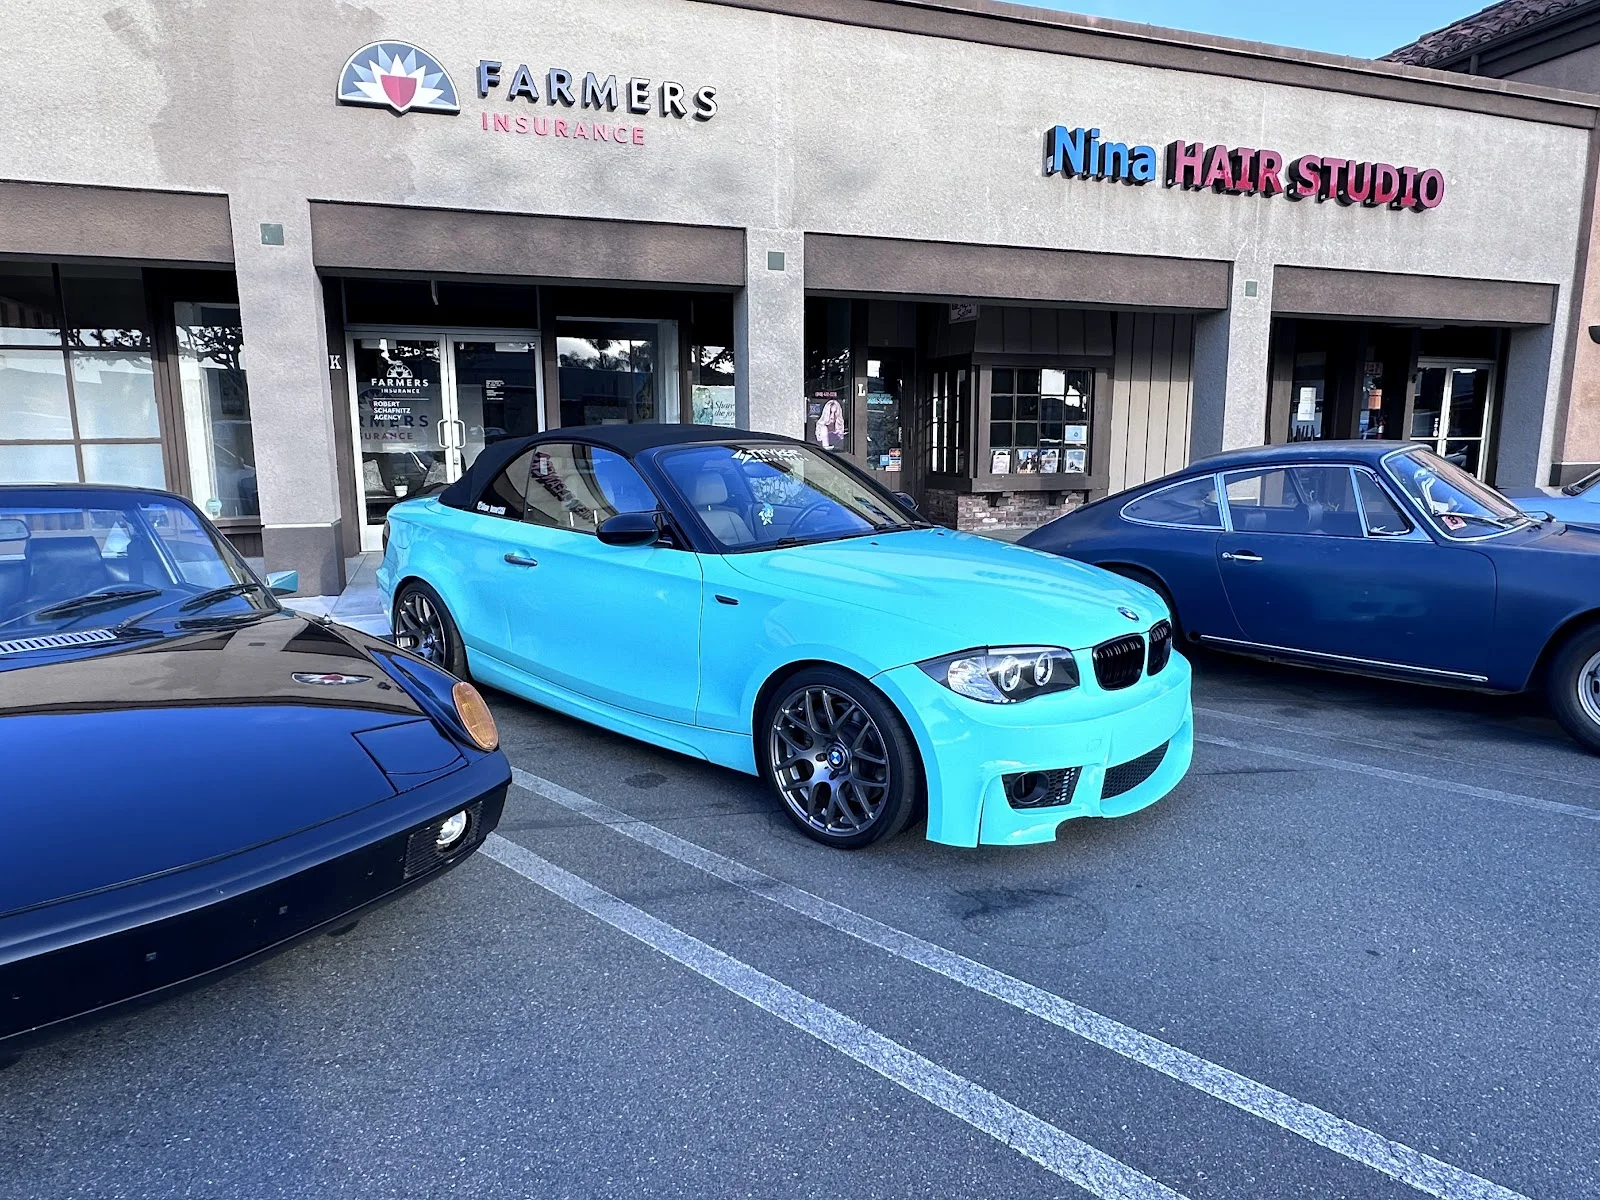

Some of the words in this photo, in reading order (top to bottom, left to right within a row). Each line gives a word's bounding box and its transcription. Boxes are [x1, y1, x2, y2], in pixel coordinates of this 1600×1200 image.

[477, 59, 719, 122] FARMERS
[481, 112, 646, 146] INSURANCE
[1044, 124, 1157, 184] Nina
[1166, 138, 1284, 195] HAIR
[1288, 153, 1445, 212] STUDIO
[329, 354, 342, 370] K
[371, 378, 429, 388] FARMERS
[857, 383, 866, 397] L
